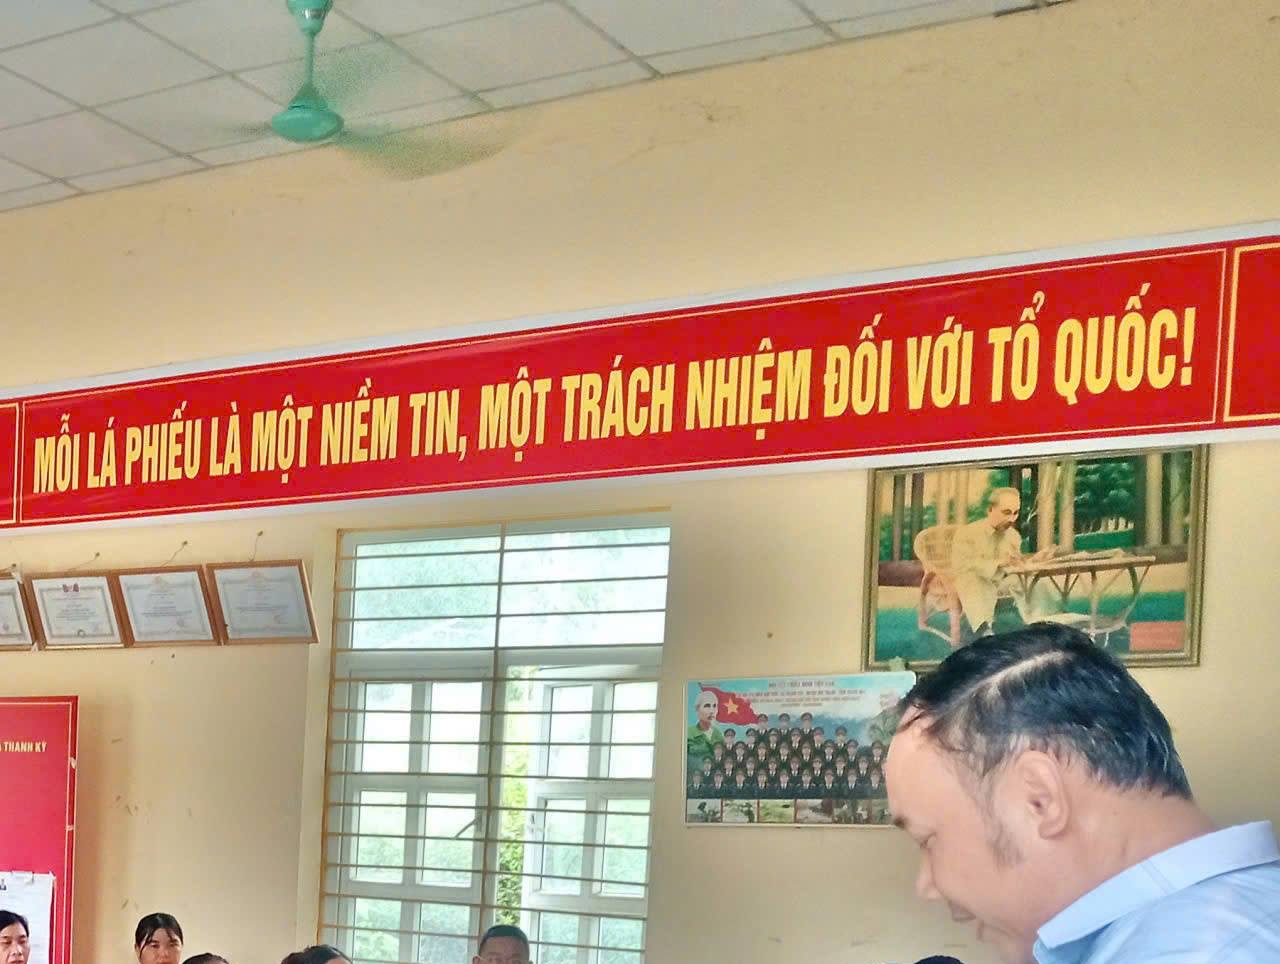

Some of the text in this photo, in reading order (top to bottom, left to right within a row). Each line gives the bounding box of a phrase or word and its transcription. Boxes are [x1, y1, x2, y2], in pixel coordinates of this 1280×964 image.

[32, 282, 1197, 494] MỖI LÁ PHIẾU LÀ MỘT NIỀM TIN, MỘT TRÁCH NHIỆM ĐỐI VỚI TỔ QUỐC!
[3, 741, 34, 753] THANH
